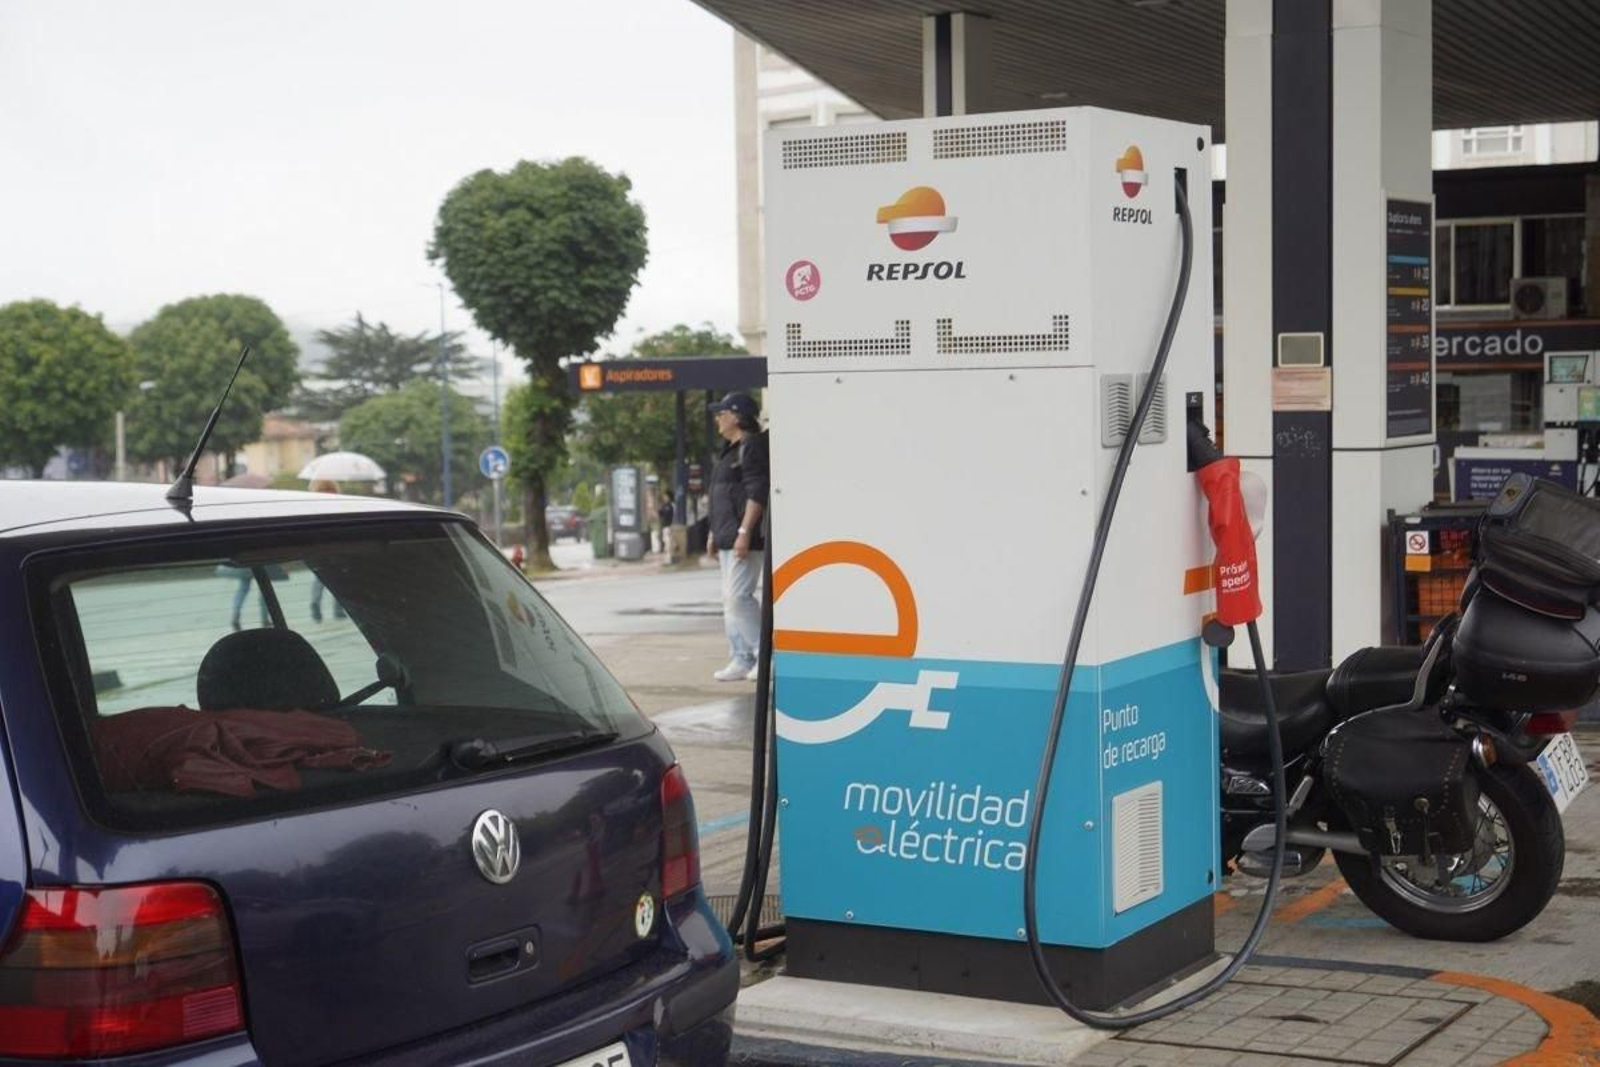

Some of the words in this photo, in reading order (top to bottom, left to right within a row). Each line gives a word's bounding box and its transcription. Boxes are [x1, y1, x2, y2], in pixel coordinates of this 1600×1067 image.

[1113, 206, 1153, 225] REPSOL
[866, 260, 967, 282] REPSOL
[606, 367, 673, 383] Aspiradores
[1102, 704, 1139, 733] Punto
[1103, 741, 1119, 769] de
[1121, 731, 1166, 764] recarga
[843, 780, 1030, 828] movilidad
[853, 819, 1027, 872] eléctrica
